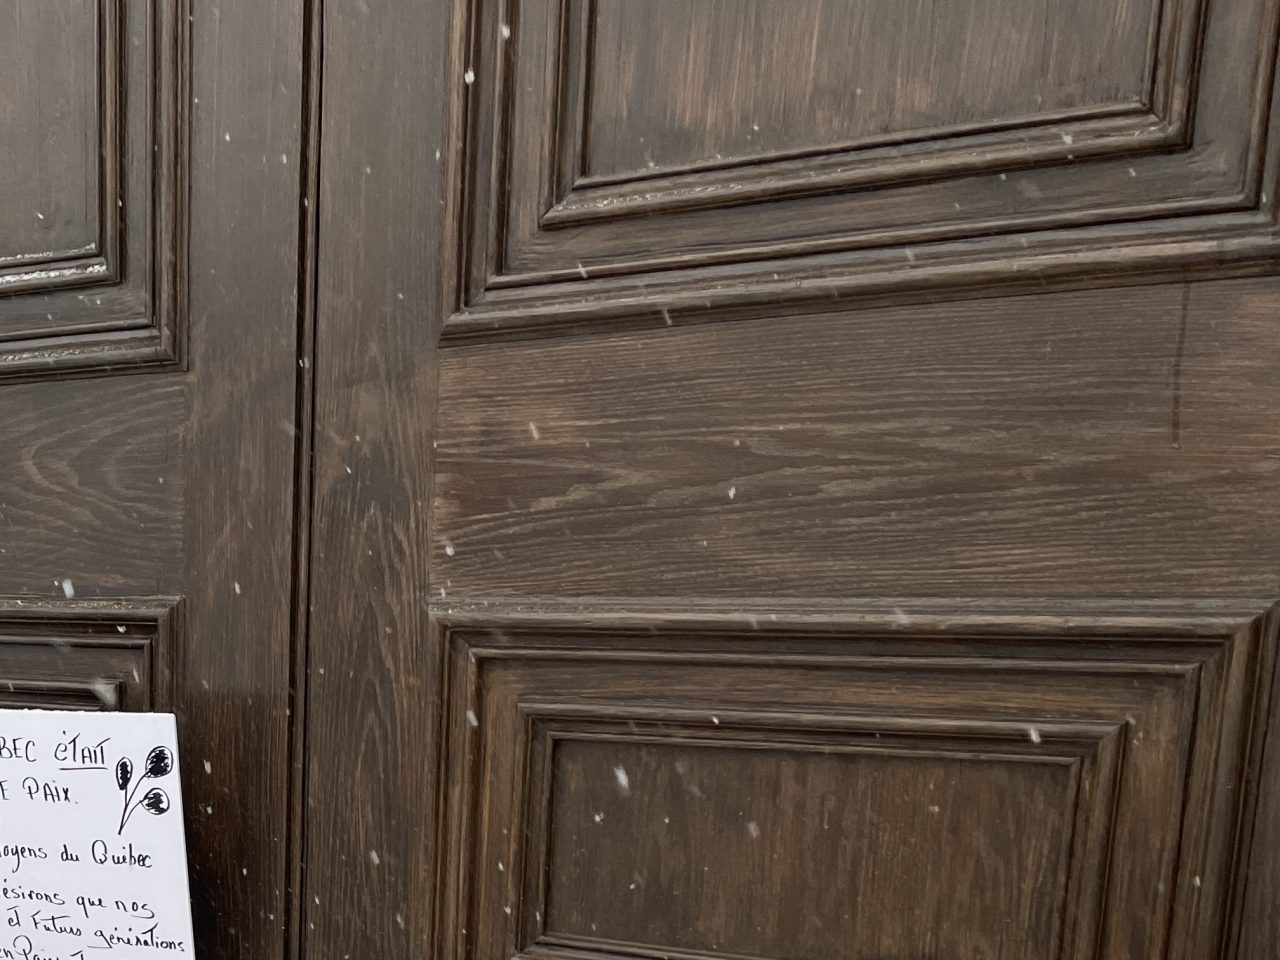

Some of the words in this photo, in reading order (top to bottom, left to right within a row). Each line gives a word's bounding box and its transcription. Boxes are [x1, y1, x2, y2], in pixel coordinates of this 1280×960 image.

[60, 844, 80, 863] du
[76, 896, 107, 918] que
[114, 899, 155, 919] nos
[87, 922, 185, 952] générations
